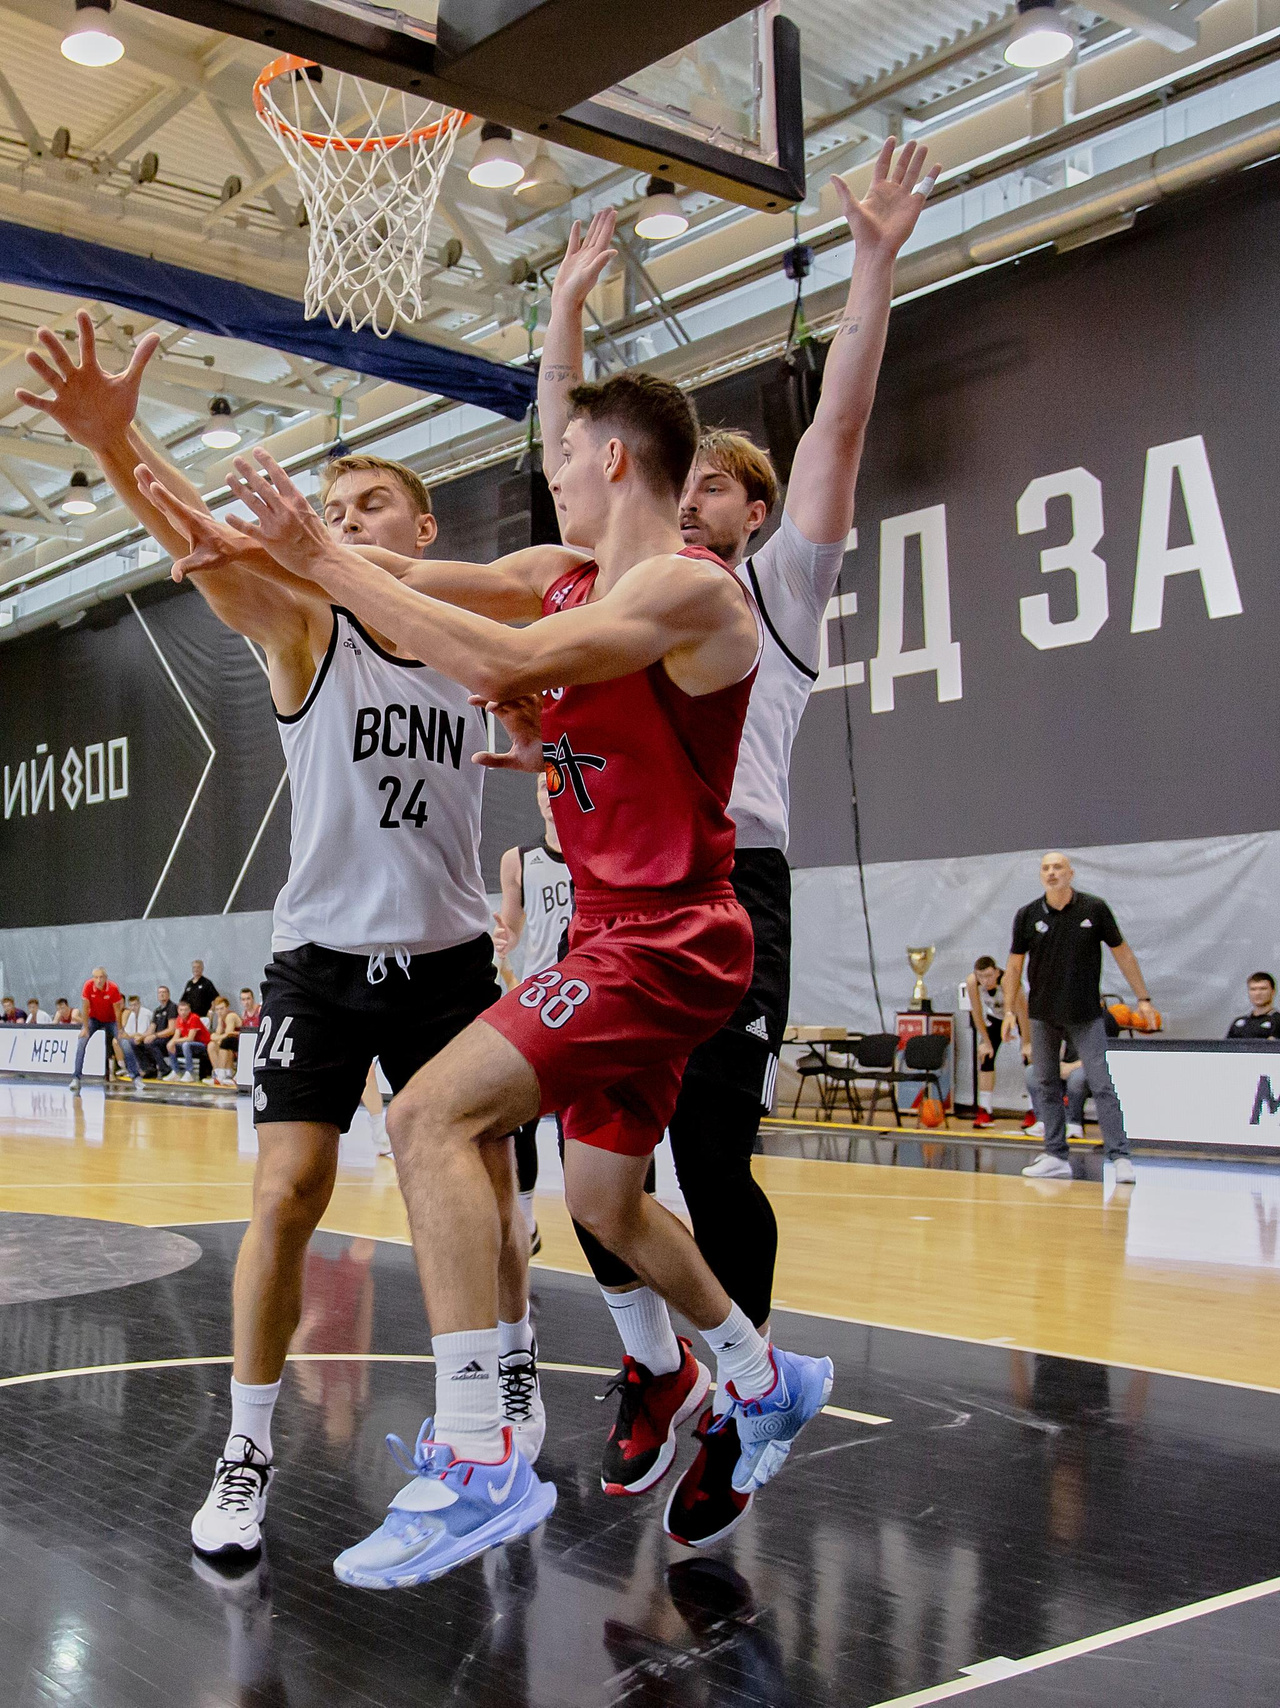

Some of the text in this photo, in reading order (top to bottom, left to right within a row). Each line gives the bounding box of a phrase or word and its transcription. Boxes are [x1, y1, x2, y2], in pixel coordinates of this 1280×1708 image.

[1016, 434, 1243, 651] ЗА
[353, 704, 465, 770] BCNN
[61, 737, 128, 811] 800
[379, 776, 428, 828] 24
[519, 970, 590, 1029] 38
[31, 1038, 69, 1063] МЕРЧ
[254, 1015, 295, 1068] 24
